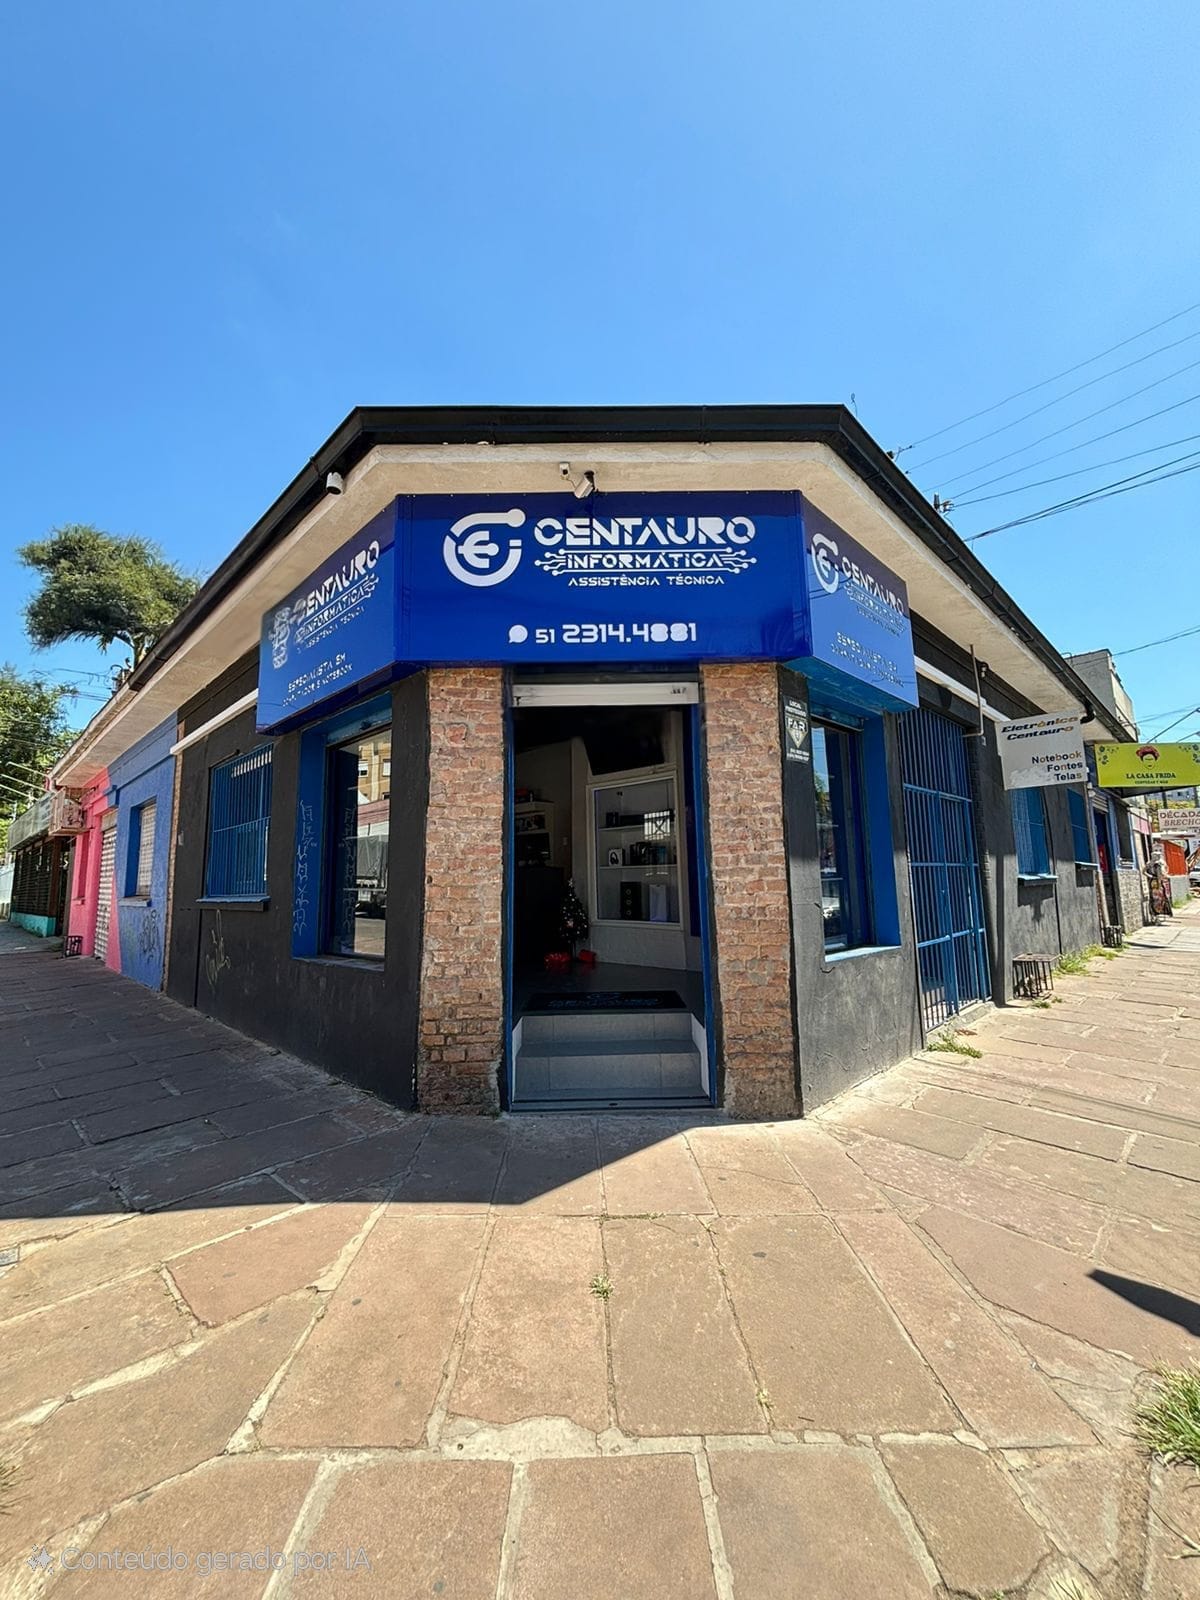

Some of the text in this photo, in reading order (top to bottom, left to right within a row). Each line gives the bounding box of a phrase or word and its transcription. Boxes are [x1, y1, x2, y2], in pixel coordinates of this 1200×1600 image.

[533, 516, 756, 546] CENTAURO
[567, 551, 724, 569] INFORMÁTICA
[568, 573, 725, 586] ASSISTÊNCIA TÉCNICA
[841, 556, 905, 616] CENTAURO
[535, 623, 697, 643] 51 2314.4881
[787, 717, 806, 732] FAR
[1007, 725, 1074, 740] Centauro
[1031, 750, 1082, 764] Notebook
[1047, 762, 1083, 772] Fontes
[1054, 773, 1082, 781] Telas
